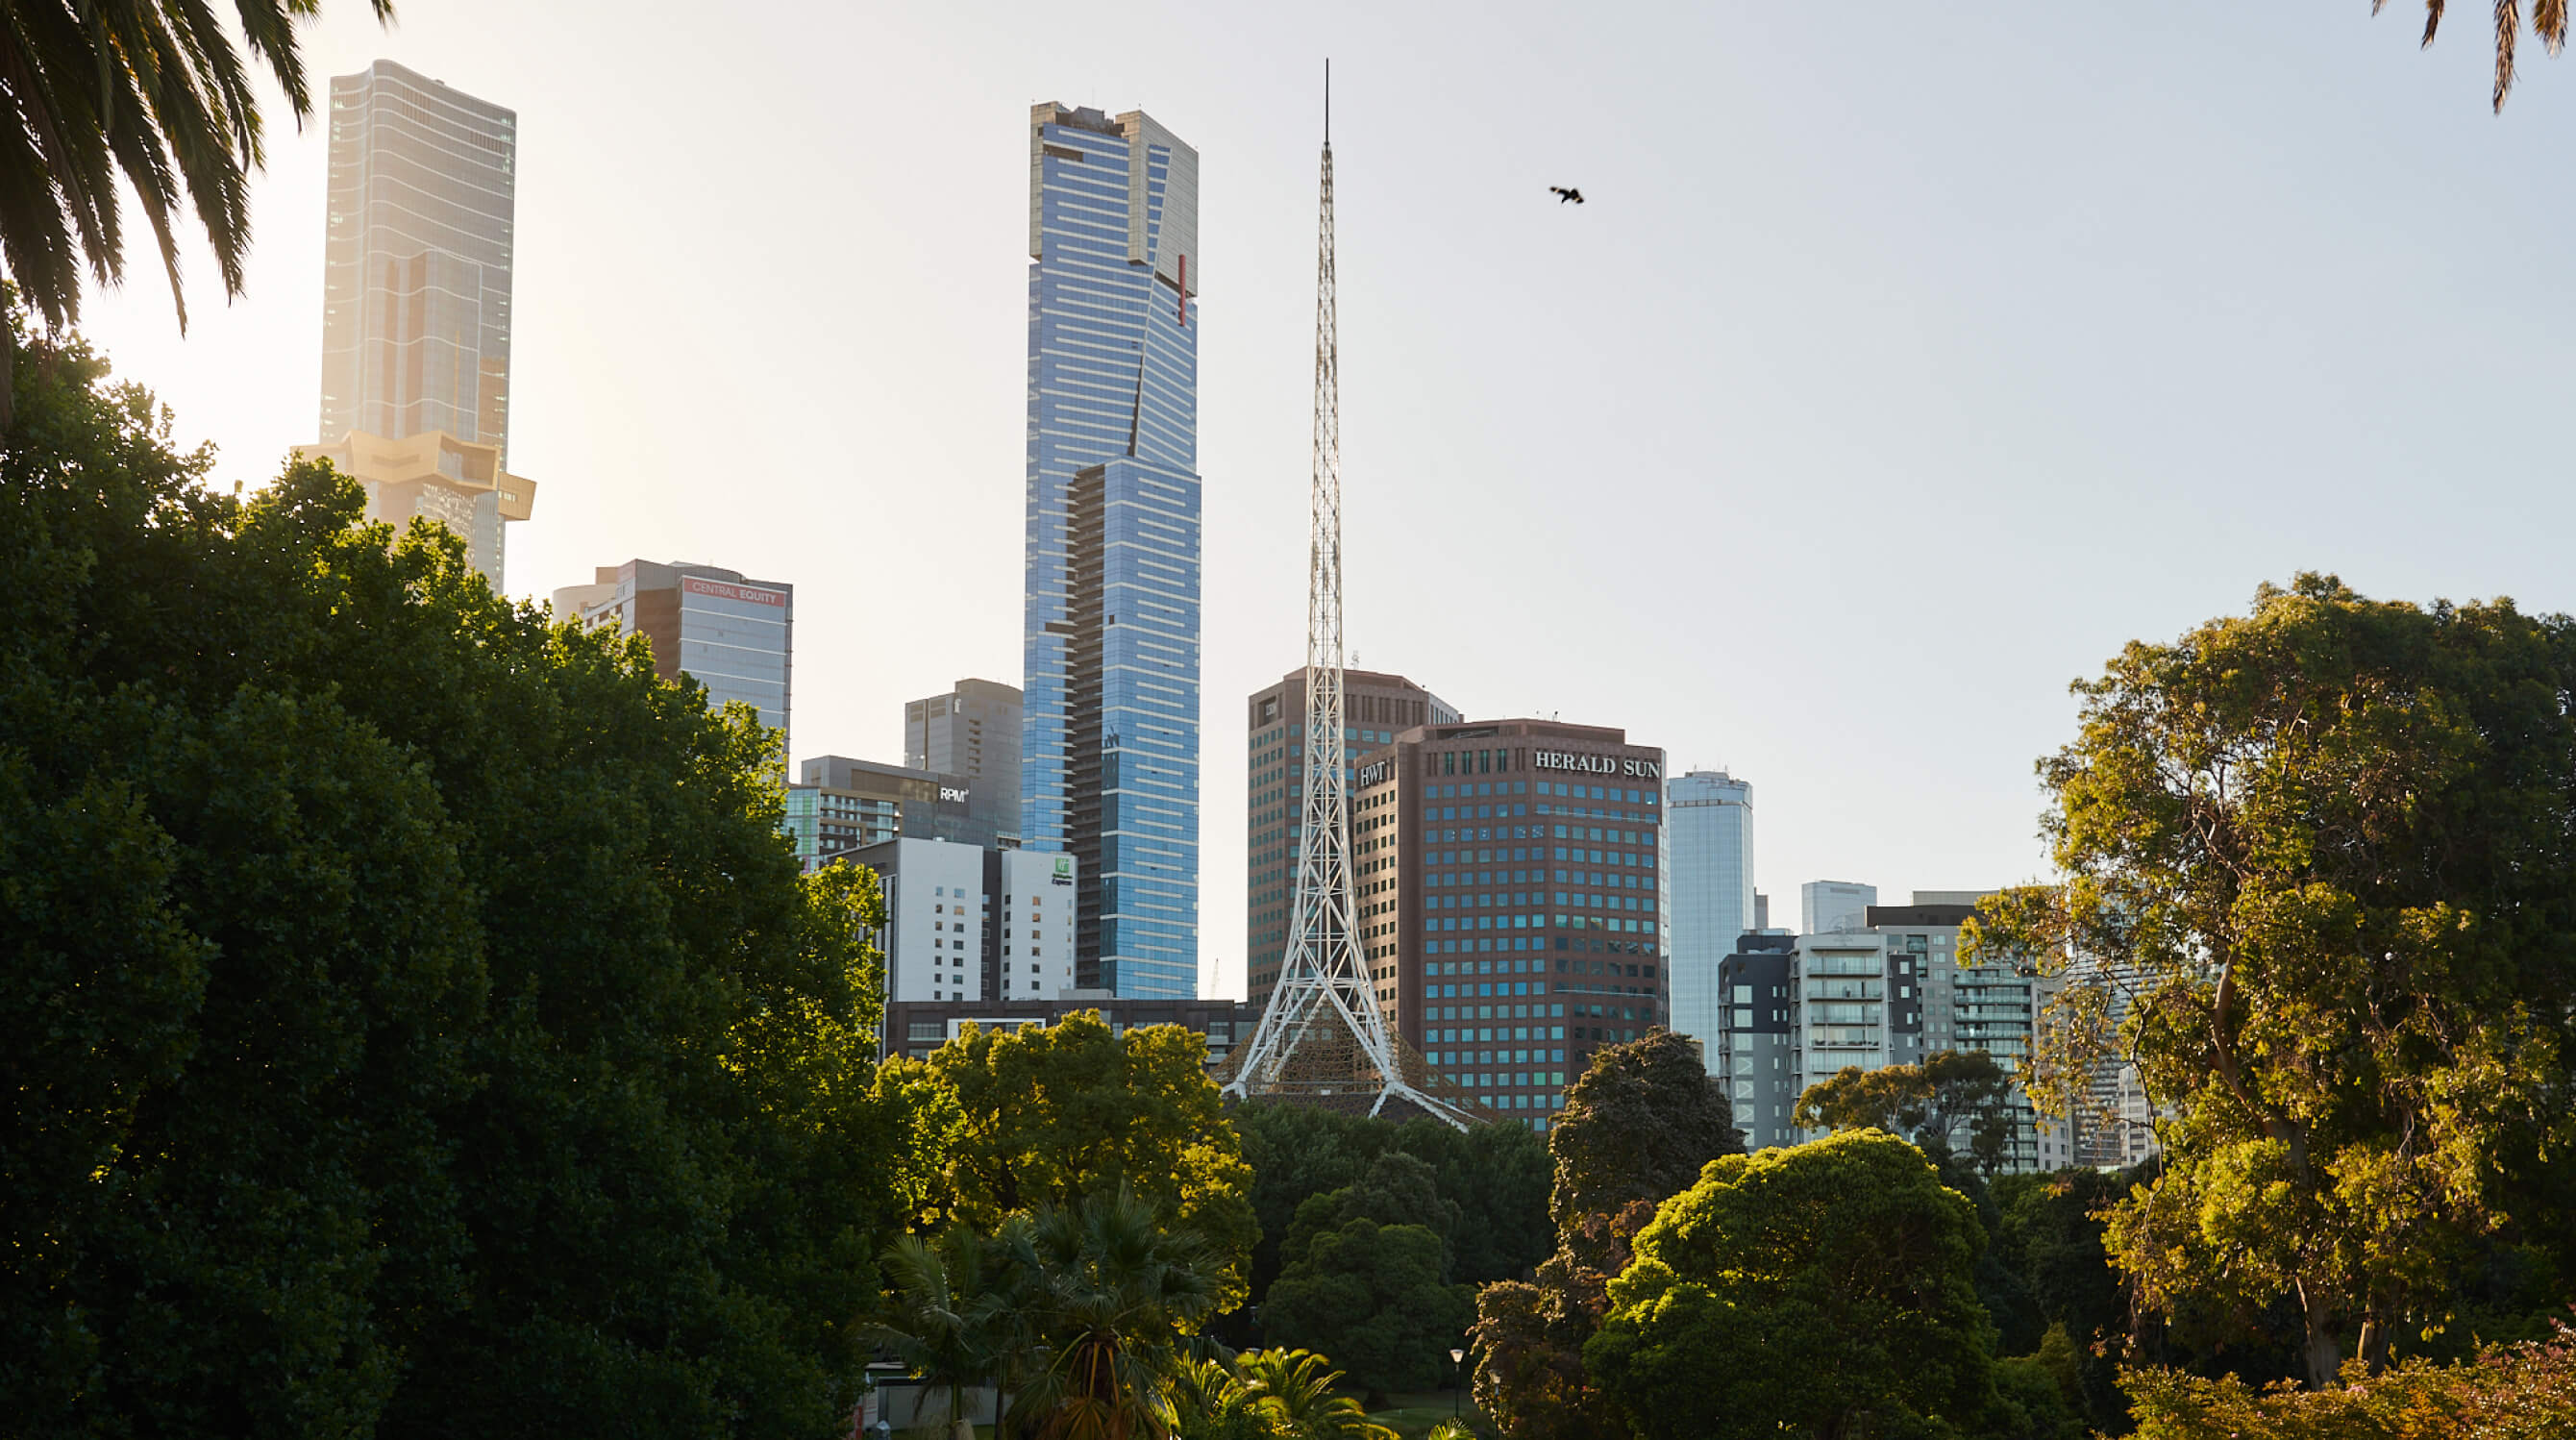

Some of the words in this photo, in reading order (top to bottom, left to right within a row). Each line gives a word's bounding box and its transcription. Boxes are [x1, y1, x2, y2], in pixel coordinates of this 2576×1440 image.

[692, 582, 737, 597] CENTRAL
[739, 589, 777, 604] EQUITY
[1361, 761, 1385, 786] HWT
[1535, 752, 1617, 774] HERALD
[1623, 759, 1662, 779] SUN
